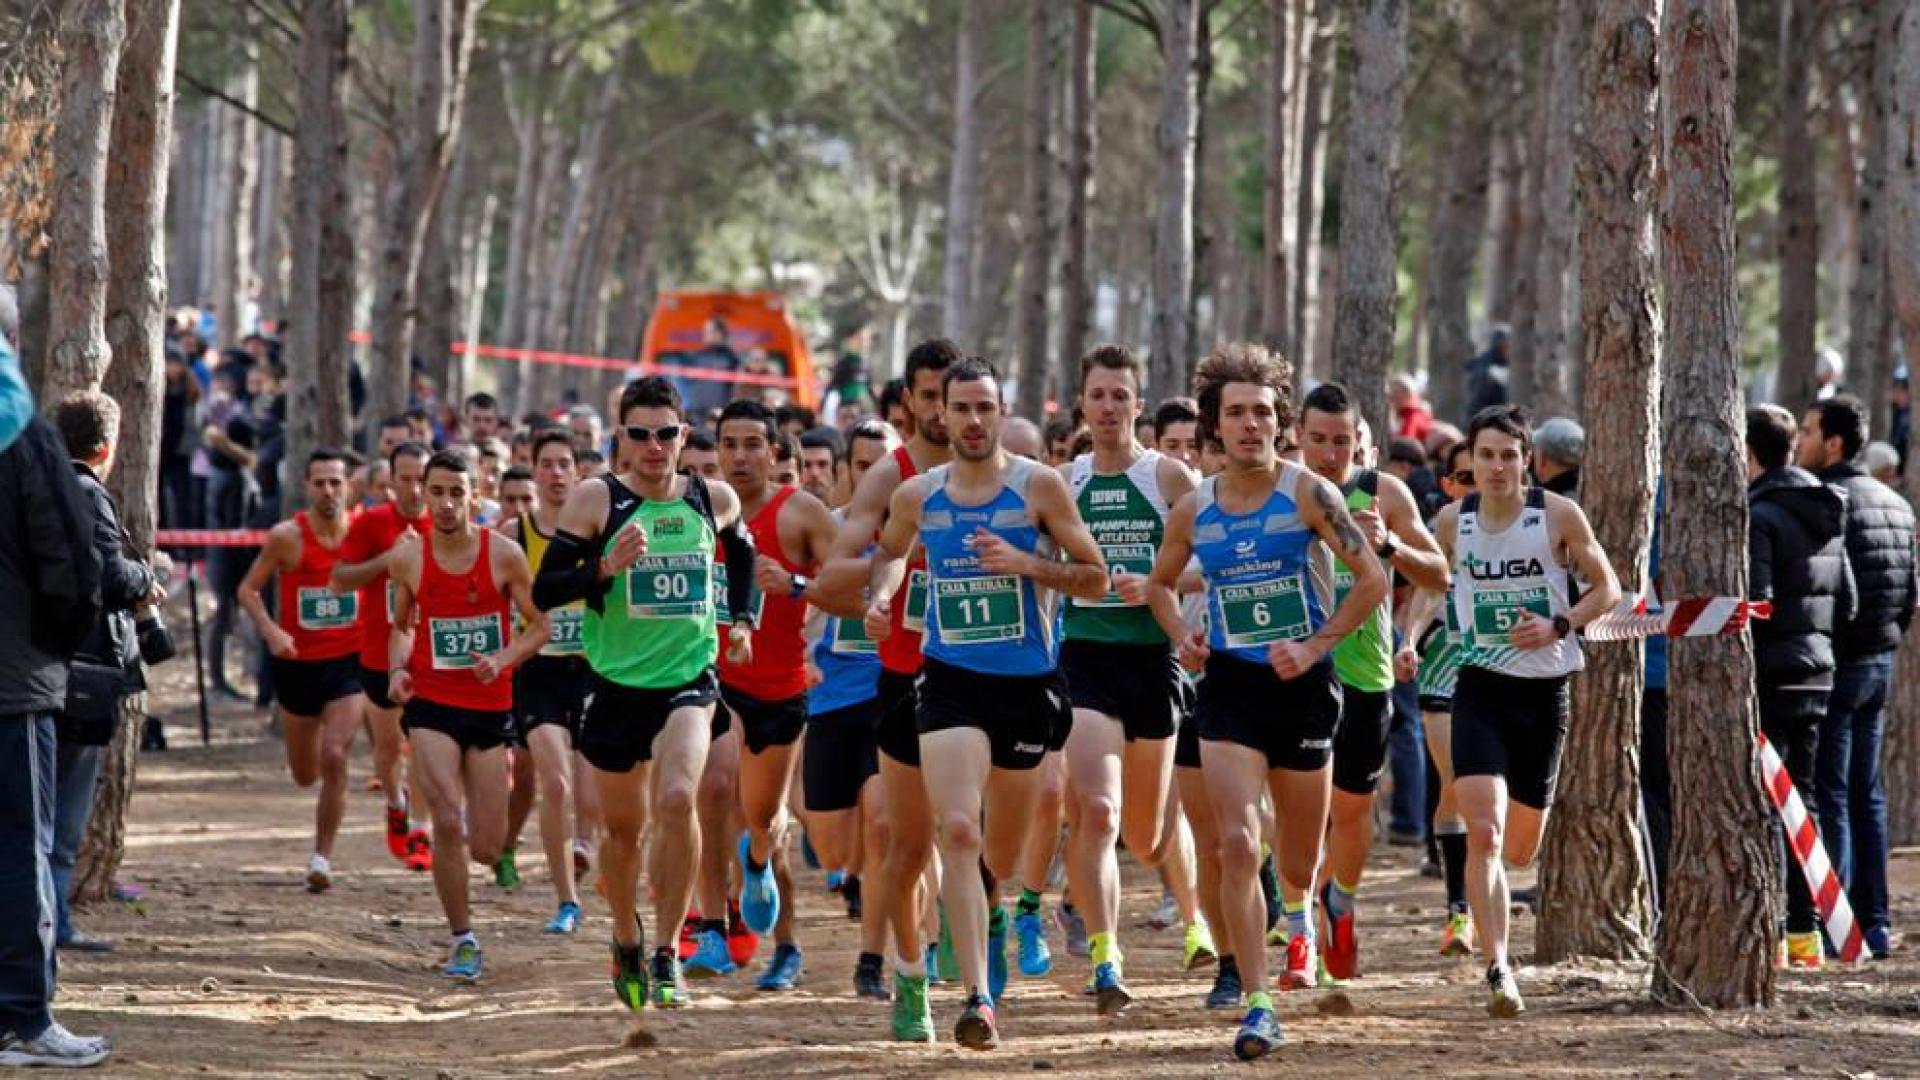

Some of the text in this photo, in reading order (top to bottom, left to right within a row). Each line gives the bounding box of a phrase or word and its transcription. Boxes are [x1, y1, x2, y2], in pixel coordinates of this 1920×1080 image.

[653, 573, 688, 599] 90
[958, 597, 990, 624] 11
[1253, 602, 1271, 627] 6
[444, 631, 487, 654] 379
